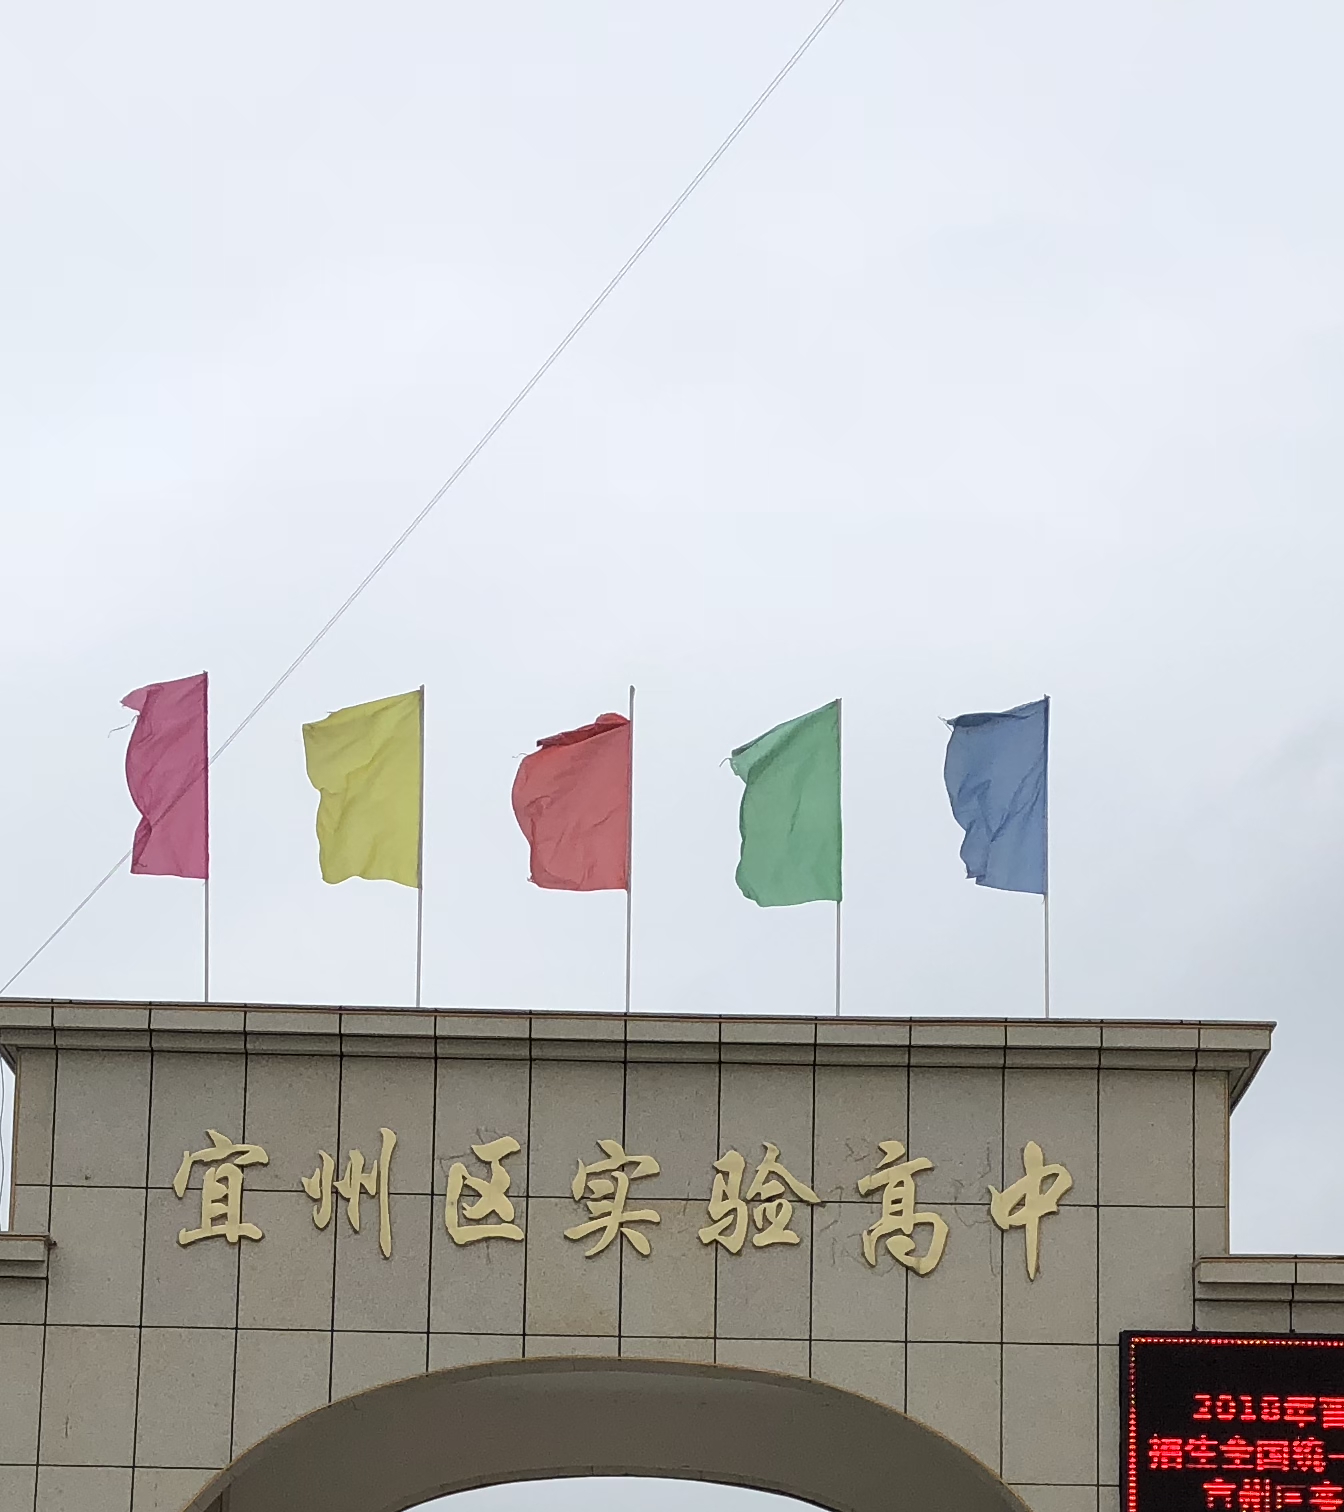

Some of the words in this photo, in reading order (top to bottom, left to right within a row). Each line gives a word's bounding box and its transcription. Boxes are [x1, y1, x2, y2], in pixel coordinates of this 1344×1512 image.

[172, 1128, 1074, 1282] 宜州区实验高中
